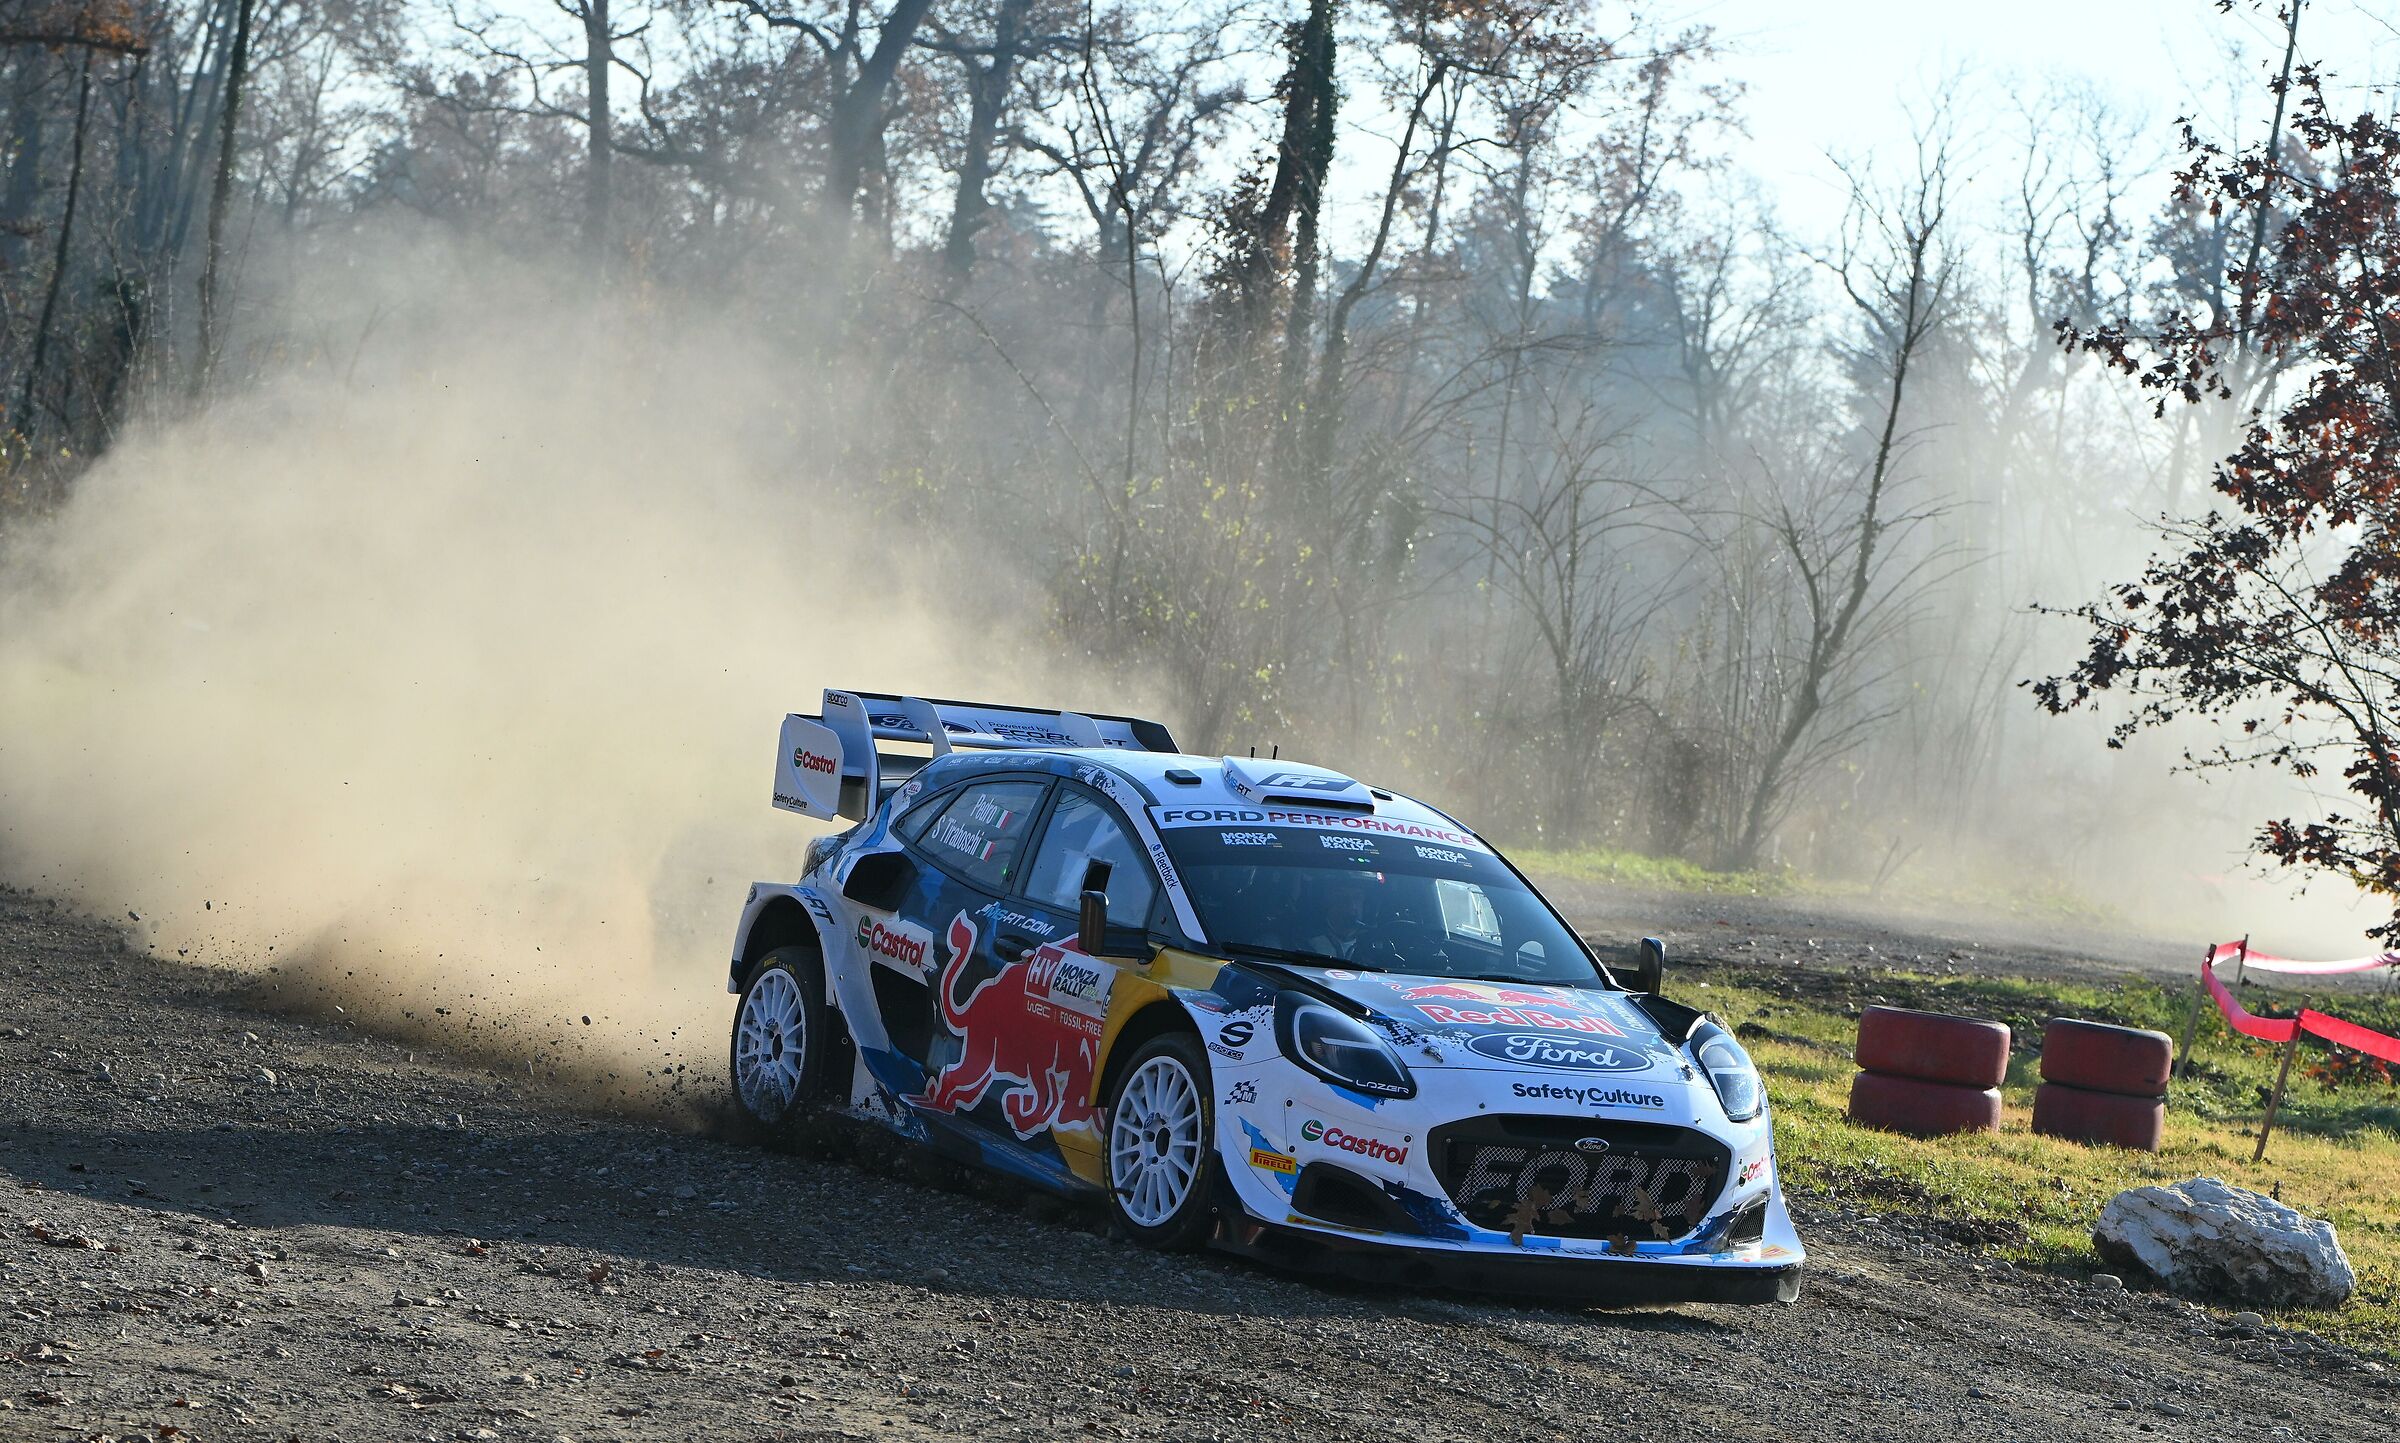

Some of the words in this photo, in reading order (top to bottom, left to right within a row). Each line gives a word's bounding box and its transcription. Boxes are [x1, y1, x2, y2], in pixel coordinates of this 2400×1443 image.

[827, 692, 848, 705] sparco
[803, 750, 837, 775] Castrol
[773, 792, 808, 809] SafetyCulture
[970, 793, 999, 825] Pedro
[931, 814, 946, 840] S
[940, 816, 985, 857] Tiraboschi
[1163, 810, 1265, 823] FORD
[1268, 811, 1477, 847] PERFORMANCE
[1220, 832, 1278, 842] MONZA
[1319, 835, 1375, 847] MONZA
[1224, 838, 1268, 846] RALLY
[1322, 842, 1366, 851] RALLY
[1414, 846, 1468, 861] MONZA
[1154, 851, 1179, 890] Fleetback
[1417, 853, 1459, 864] RALLY
[870, 922, 927, 968] Castrol
[1028, 955, 1058, 988] HY
[1057, 962, 1101, 988] MONZA
[1052, 976, 1087, 998] RALLY
[1027, 1000, 1051, 1019] WRC
[1060, 1011, 1102, 1037] FOSSIL-FREE
[1413, 1004, 1534, 1027] Red
[1517, 1009, 1629, 1039] Bull
[1208, 1042, 1244, 1060] sparco
[1505, 1035, 1621, 1067] Ford
[1512, 1083, 1664, 1107] SafetyCulture
[1323, 1127, 1408, 1165] Castrol
[1253, 1152, 1292, 1172] PIRELLI
[1456, 1145, 1708, 1217] FORD
